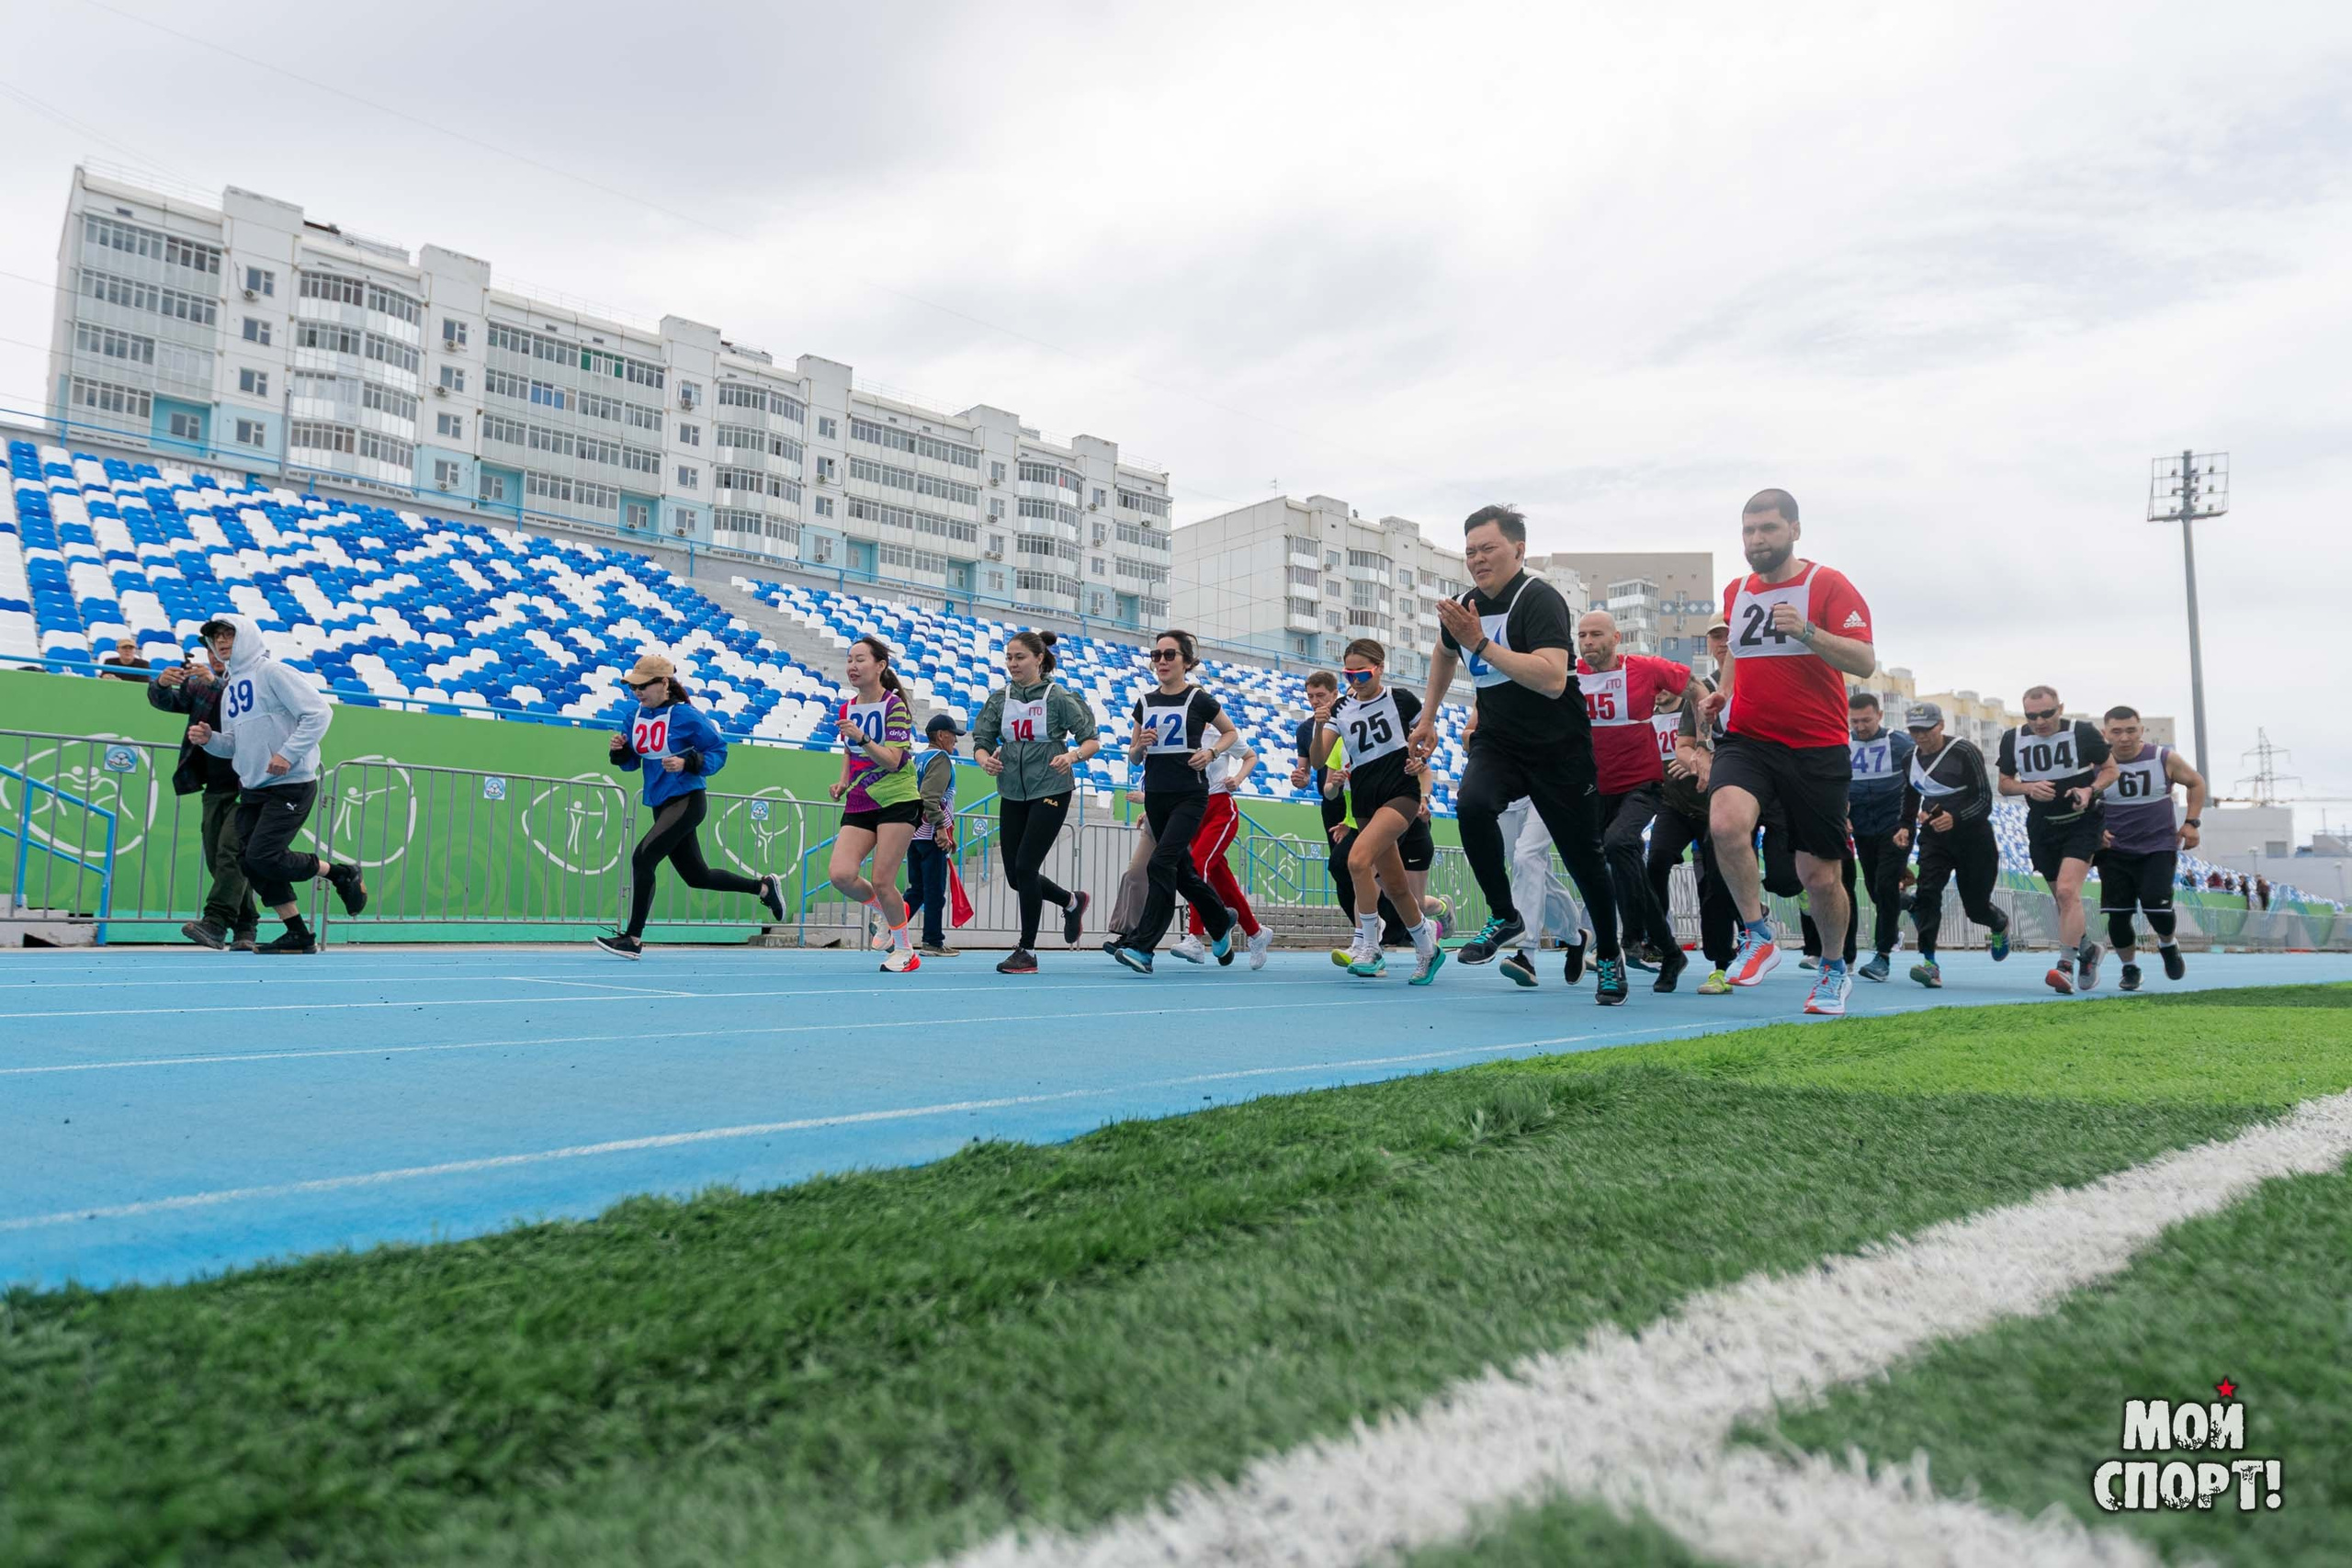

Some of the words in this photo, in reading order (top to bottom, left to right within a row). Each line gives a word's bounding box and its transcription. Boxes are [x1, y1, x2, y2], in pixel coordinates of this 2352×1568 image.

[1740, 601, 1788, 646] 24
[1605, 678, 1622, 690] ГТО
[228, 680, 254, 718] 39
[1028, 706, 1043, 716] ГТО
[635, 721, 666, 754] 20
[1012, 719, 1035, 741] 14
[1350, 710, 1393, 753] 25
[1851, 745, 1887, 773] 47
[2019, 740, 2074, 773] 104
[2119, 770, 2151, 797] 67
[1044, 798, 1058, 807] FILA
